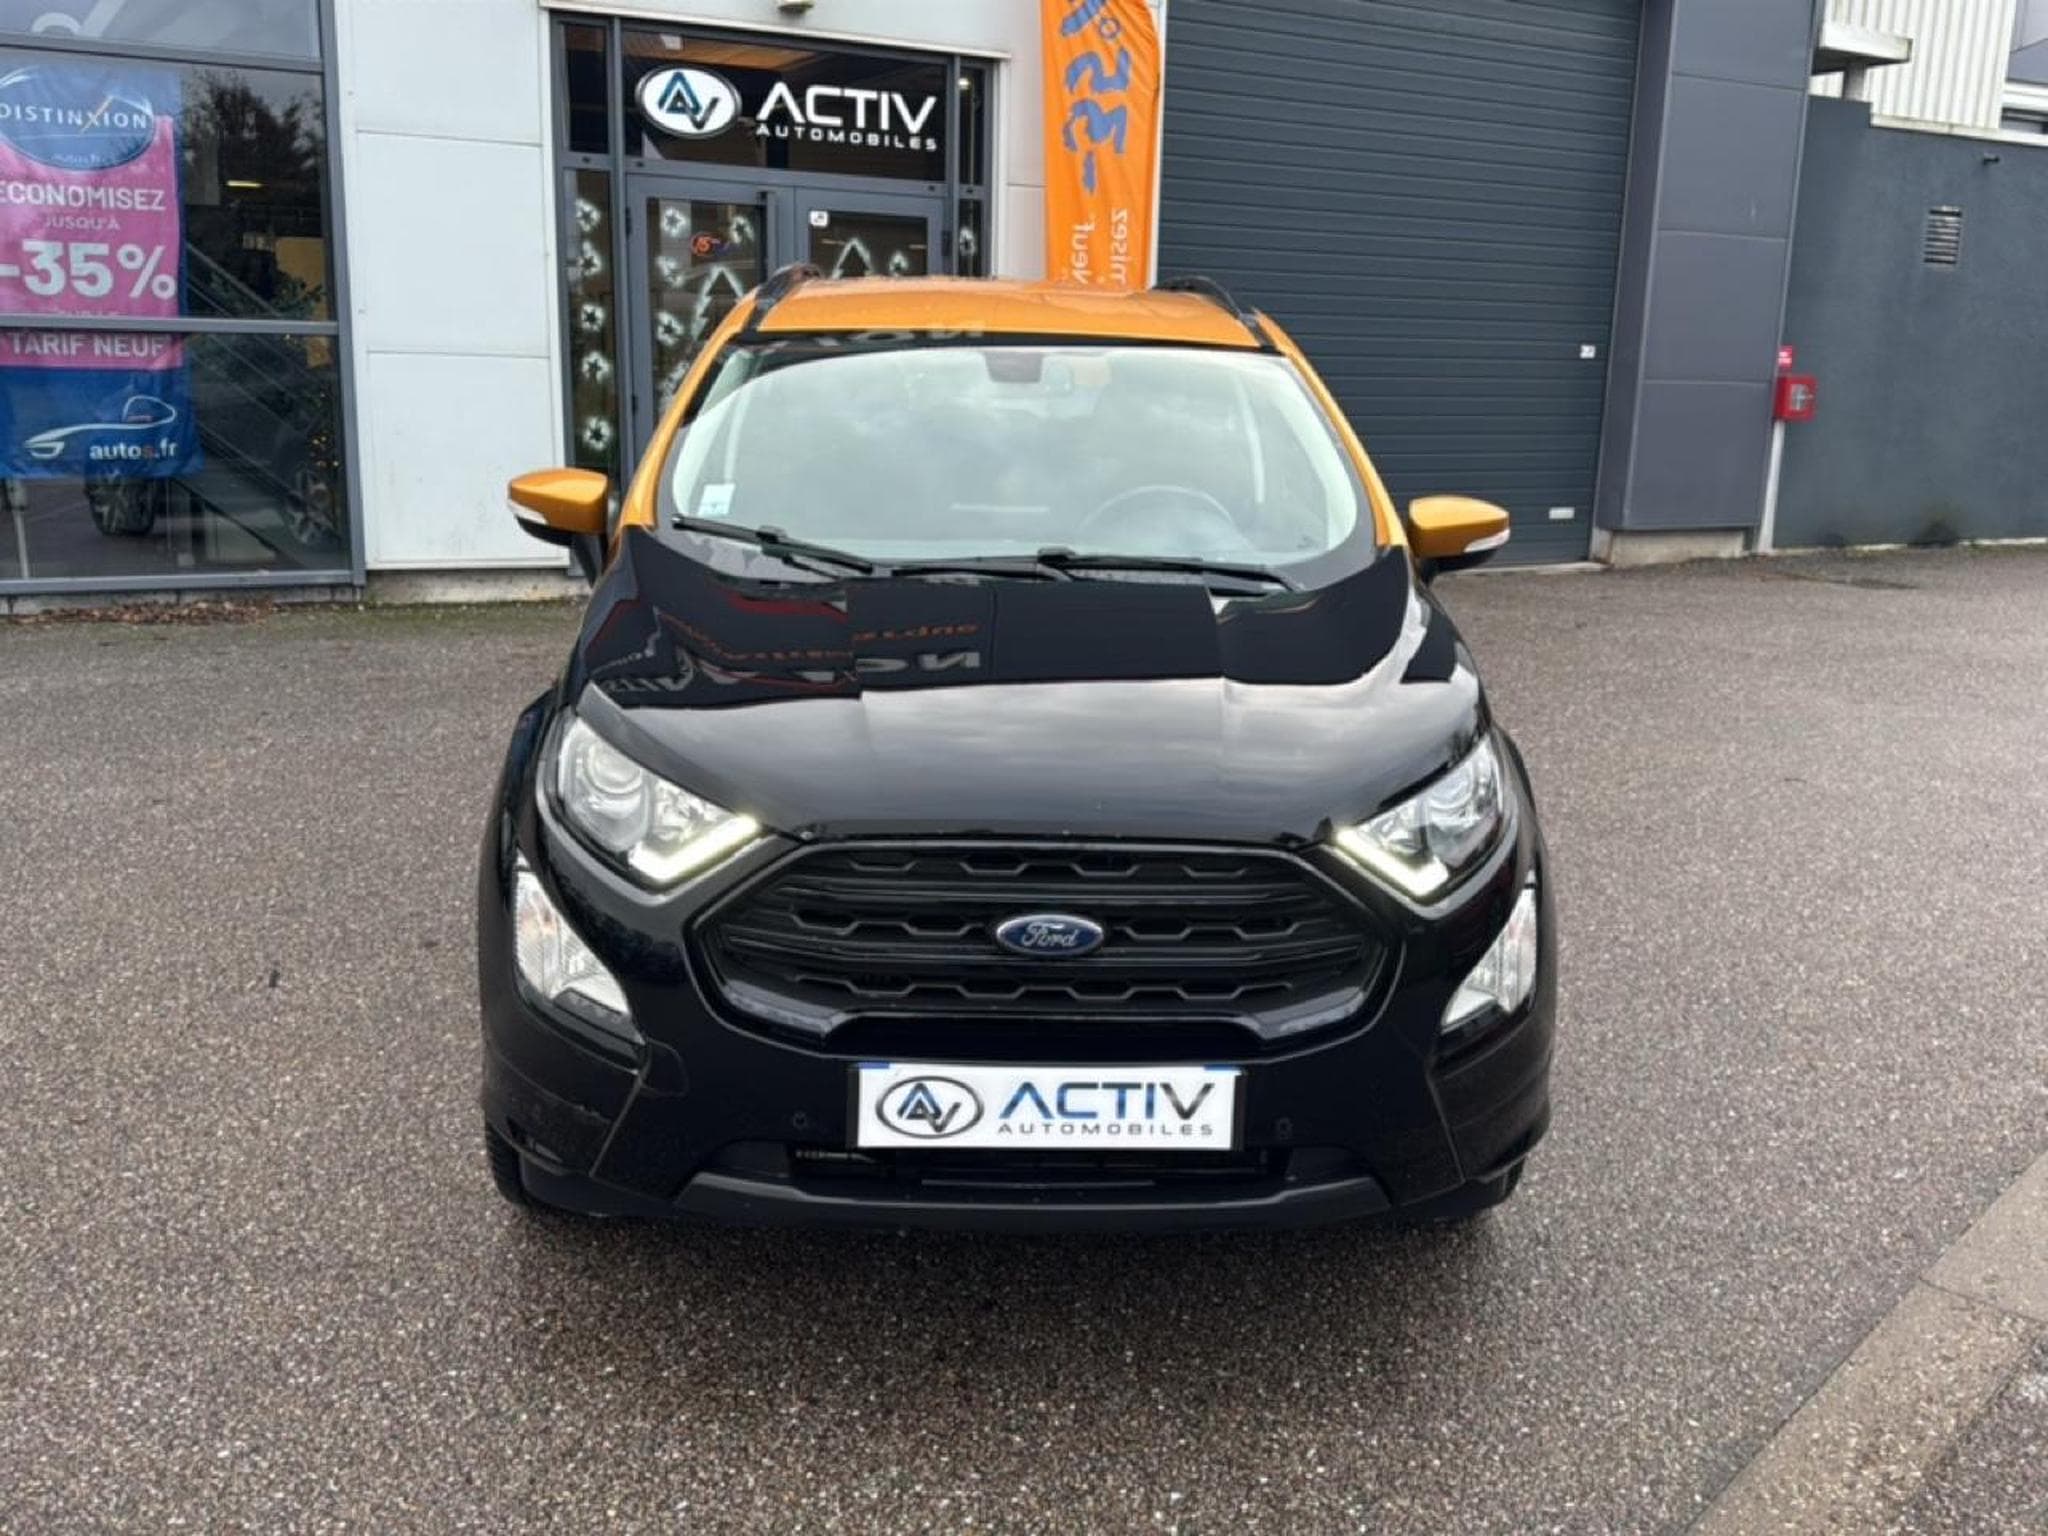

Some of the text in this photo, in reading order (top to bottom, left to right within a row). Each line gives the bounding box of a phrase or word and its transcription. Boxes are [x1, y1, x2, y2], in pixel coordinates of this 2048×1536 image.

[755, 81, 937, 135] ACTIV
[755, 122, 938, 152] AUTOMOBILES
[11, 332, 85, 356] TARIF
[1021, 921, 1080, 947] Ford
[999, 1082, 1215, 1120] ACTIV
[998, 1123, 1214, 1136] AUTOMOBILES
